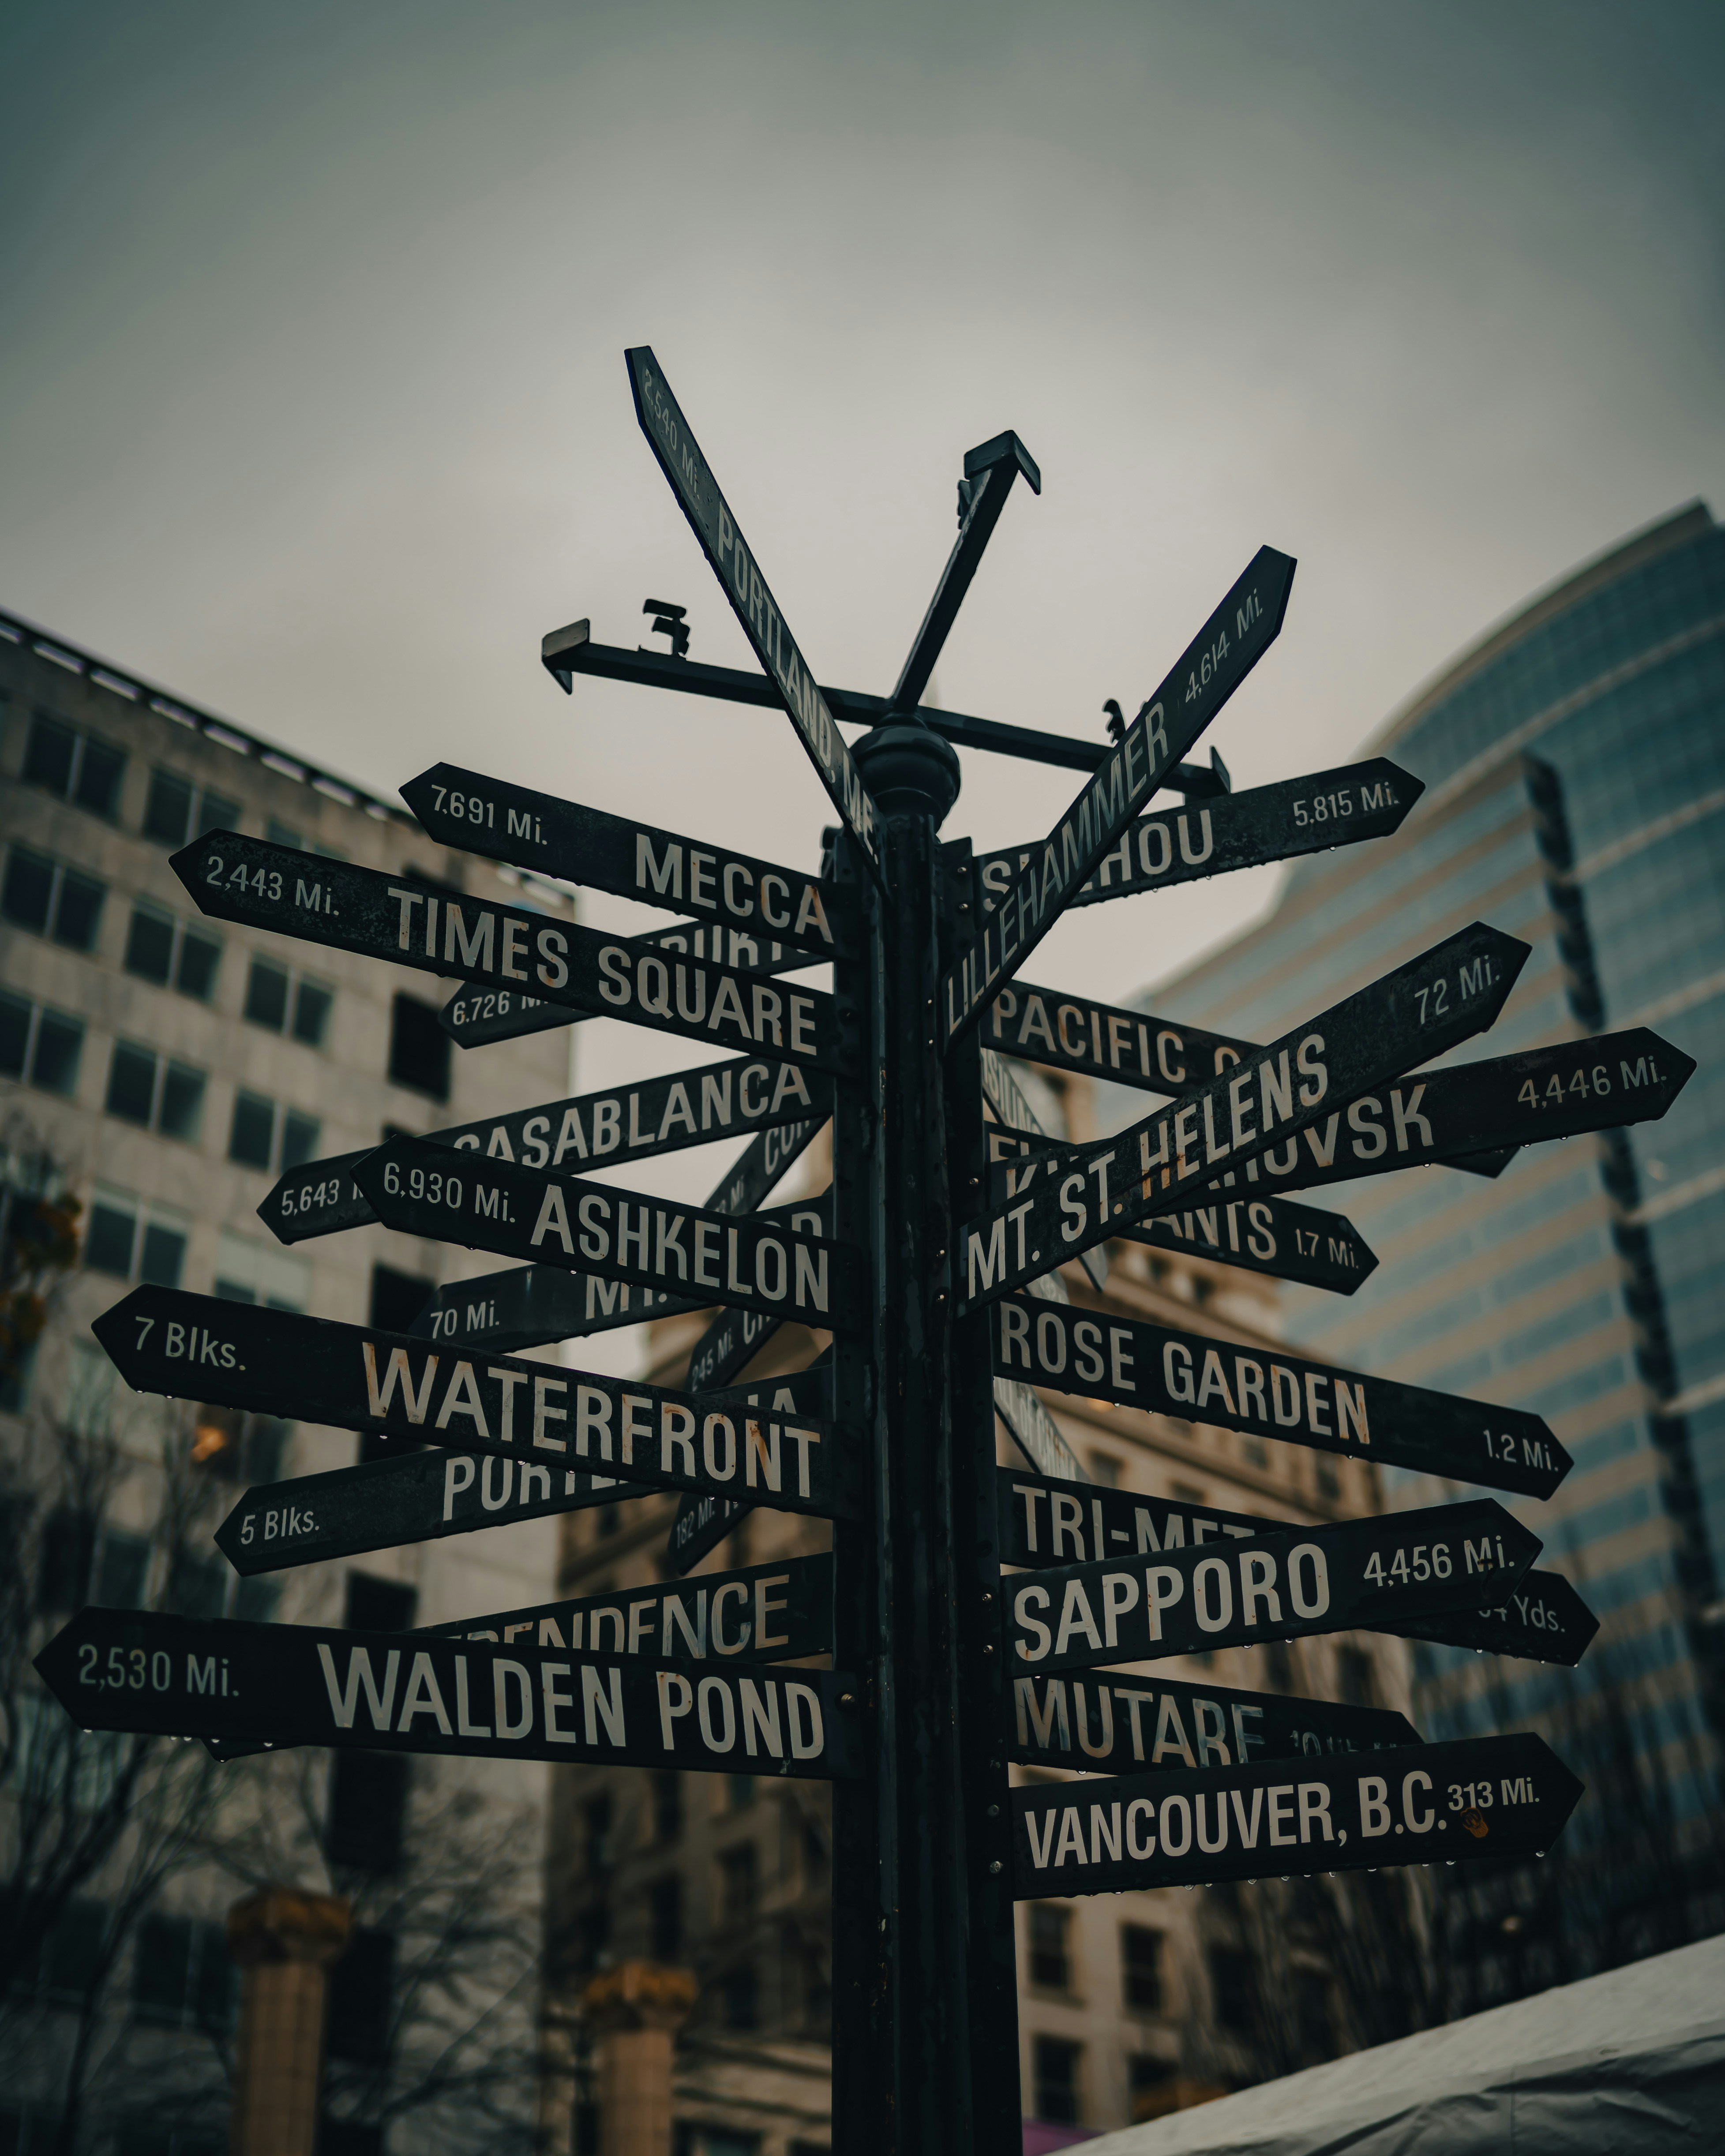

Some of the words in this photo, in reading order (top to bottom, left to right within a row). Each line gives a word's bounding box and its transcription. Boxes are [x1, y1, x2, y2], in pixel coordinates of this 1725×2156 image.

[682, 442, 700, 500] Mi.
[718, 501, 836, 783] PORTLAND,
[843, 751, 878, 865] ME.
[431, 785, 494, 828] 7,691
[508, 808, 547, 845] Mi.
[636, 833, 834, 944] MECCA
[948, 702, 1169, 1036] LILLEHAMMER
[1185, 631, 1230, 703] 4,614
[1237, 588, 1263, 640] Mi.
[982, 809, 1213, 912] SHOU
[1361, 782, 1400, 811] Mi.
[207, 857, 282, 900] 2,443
[295, 879, 339, 916] Mi.
[388, 887, 569, 988] TIMES
[598, 946, 818, 1056] SQUARE
[991, 988, 1186, 1083] PACIFIC
[1517, 1066, 1611, 1108] 4,446
[1620, 1055, 1668, 1090] Mi.
[968, 1199, 1040, 1300] MT.
[1059, 1151, 1122, 1243] ST.
[1140, 1034, 1329, 1200] HELENS
[1414, 978, 1450, 1025] 72
[1459, 955, 1500, 1000] Mi.
[281, 1179, 339, 1216] 5,643
[384, 1163, 462, 1209] 6,930
[475, 1184, 516, 1223] Mi.
[530, 1184, 829, 1313] ASHKELON
[1295, 1228, 1320, 1258] 1.7
[1328, 1237, 1359, 1269] Mi.
[430, 1309, 457, 1339] 70
[467, 1300, 499, 1331] Mi.
[135, 1316, 155, 1351] 7
[165, 1322, 246, 1370] Blks.
[362, 1342, 820, 1498] WATERFRONT
[1000, 1301, 1136, 1392] ROSE
[1162, 1341, 1370, 1445] GARDEN
[1483, 1429, 1517, 1463] 1.2
[1523, 1438, 1559, 1472] Mi.
[240, 1515, 255, 1545] 5
[264, 1507, 320, 1540] Blks.
[677, 1511, 694, 1549] 182
[1012, 1484, 1255, 1561] TRI-M
[1014, 1543, 1330, 1662] SAPPORO
[1363, 1544, 1452, 1587] 4,456
[1464, 1535, 1515, 1574] Mi.
[1513, 1595, 1566, 1632] Yds.
[78, 1644, 171, 1692] 2,530
[186, 1654, 240, 1696] Mi.
[316, 1643, 626, 1748] WALDEN
[656, 1671, 824, 1759] POND
[1024, 1782, 1347, 1869] VANCOUVER,
[1358, 1770, 1447, 1838] B.C.
[1448, 1783, 1493, 1811] 313
[1501, 1778, 1540, 1806] Mi.
